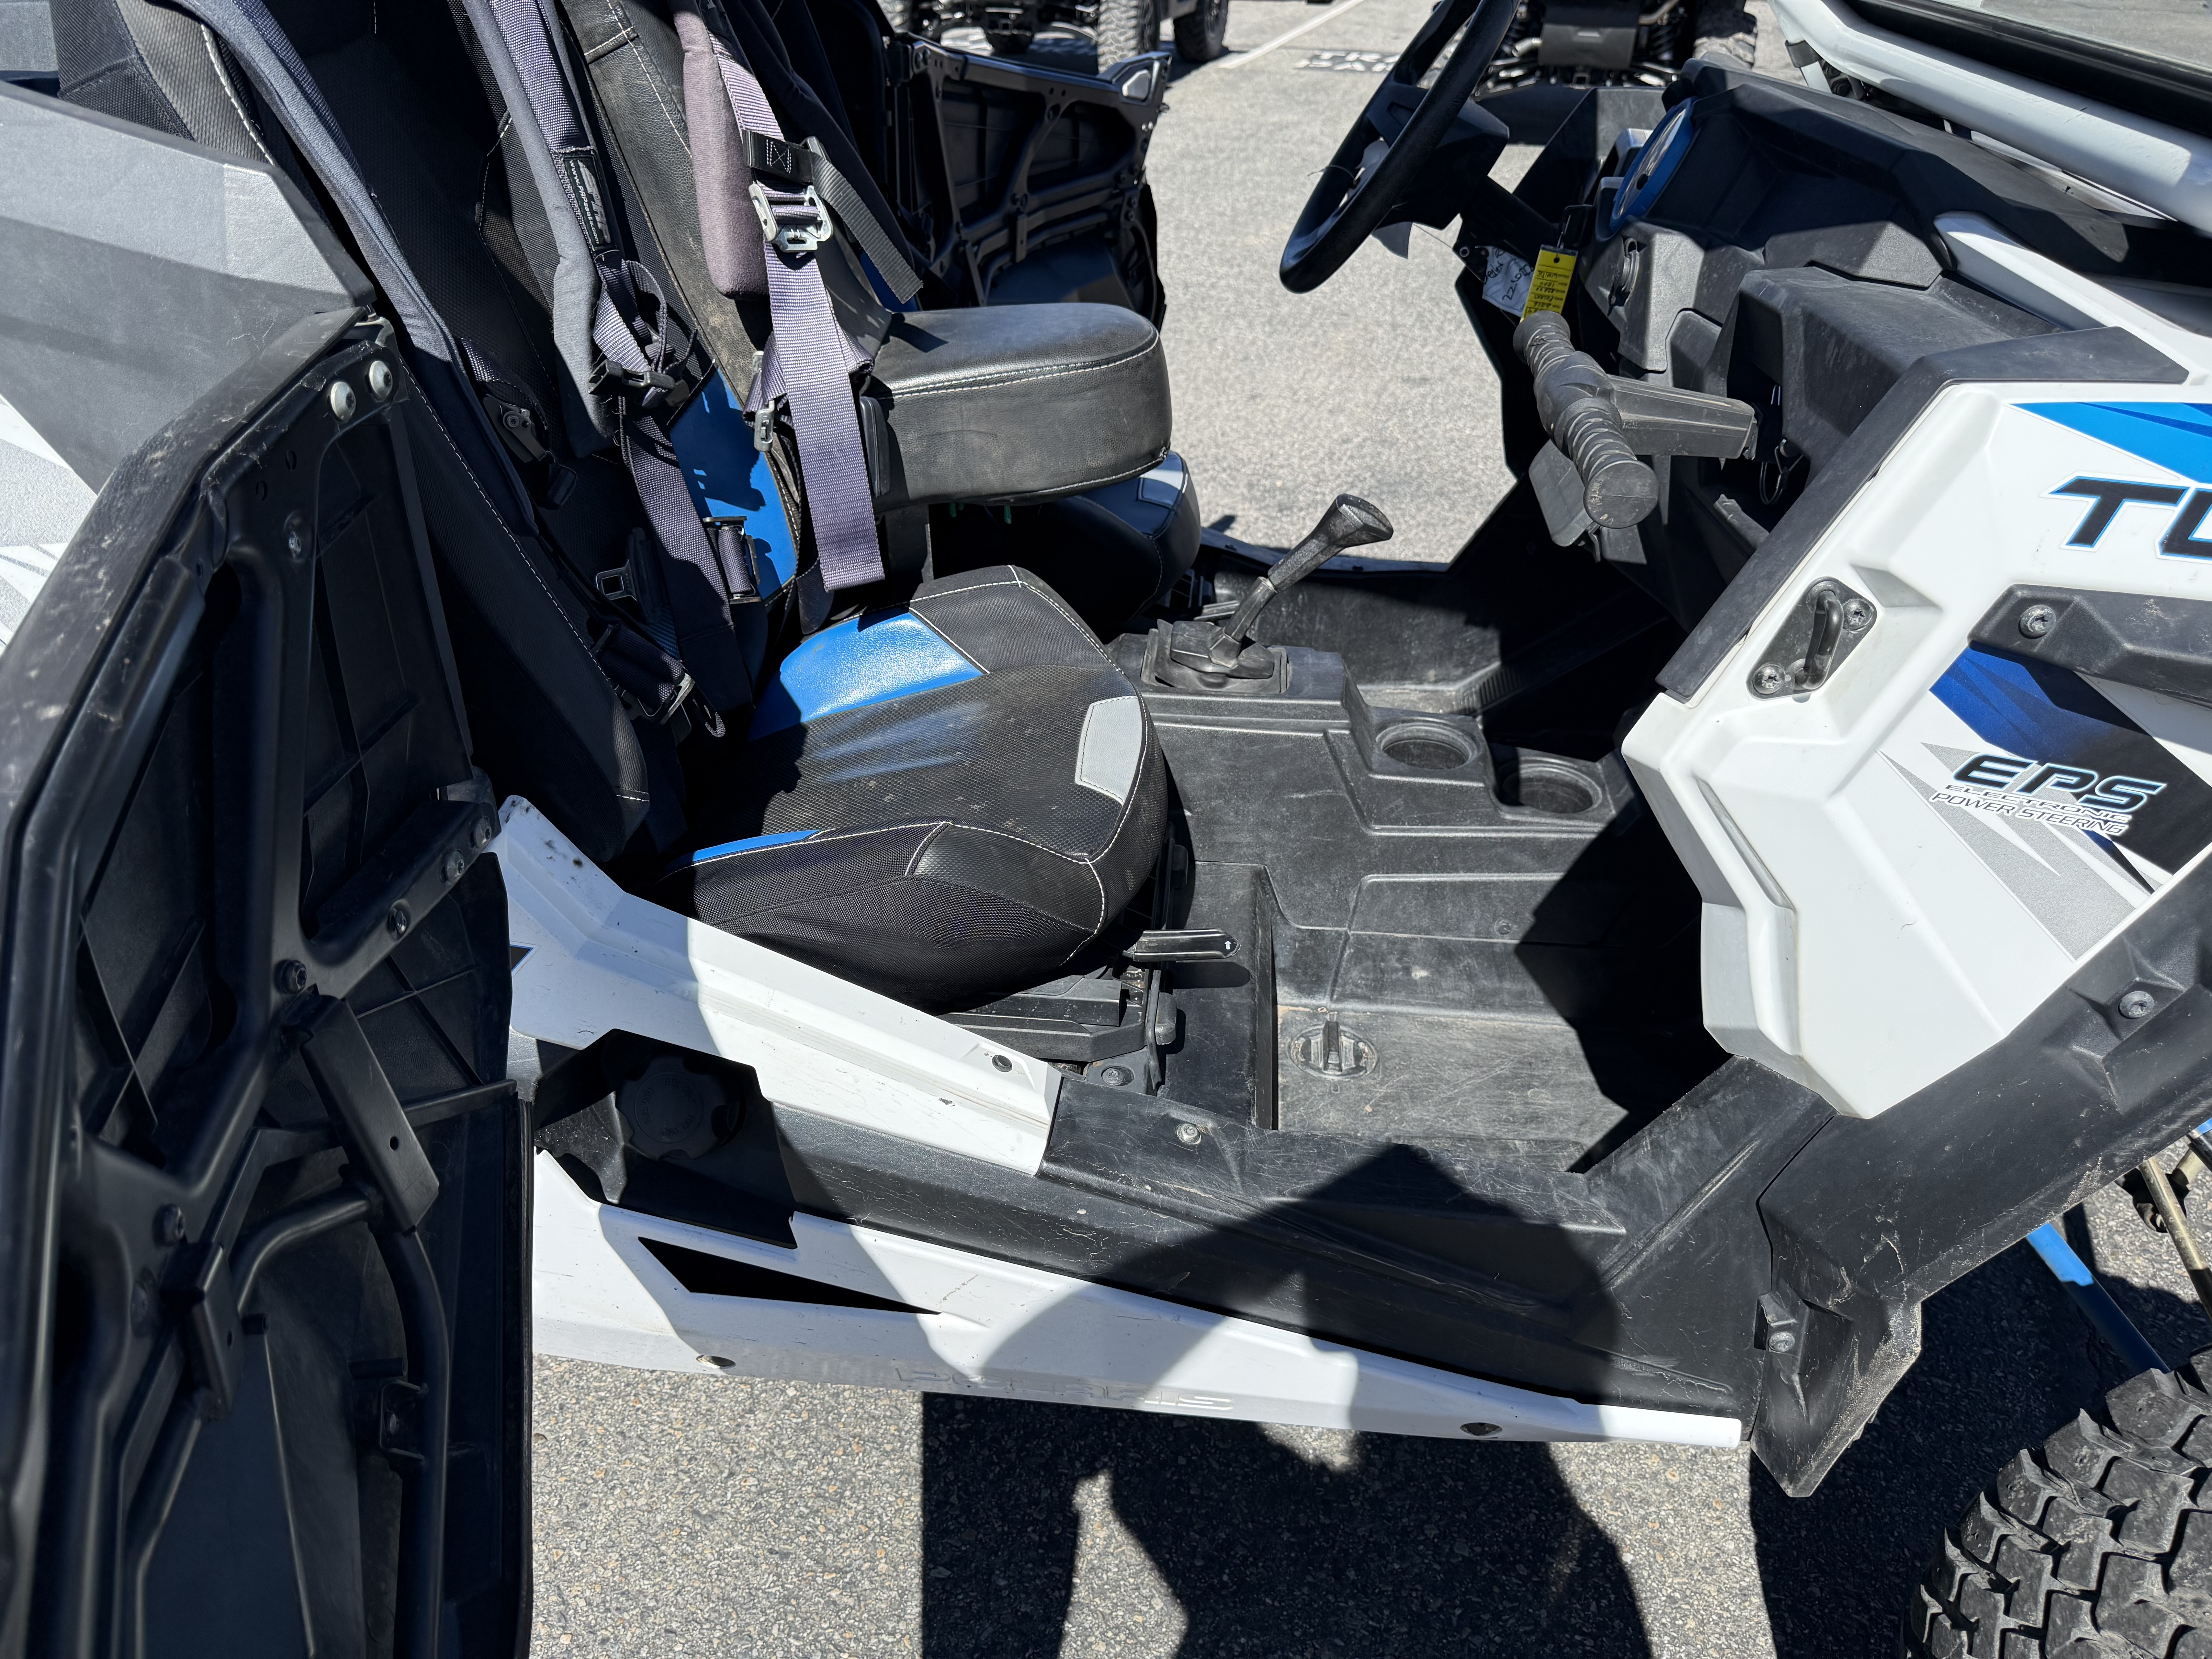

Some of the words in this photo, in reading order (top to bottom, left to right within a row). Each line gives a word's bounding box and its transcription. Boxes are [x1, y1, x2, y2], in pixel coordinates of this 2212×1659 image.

[569, 160, 599, 244] www.PRPseats.com
[1952, 753, 2167, 812] EPS
[1932, 793, 2016, 814] POWER
[2018, 809, 2127, 833] STEERING
[1945, 785, 2131, 822] ELECTRONIC
[641, 1085, 654, 1104] ONLY
